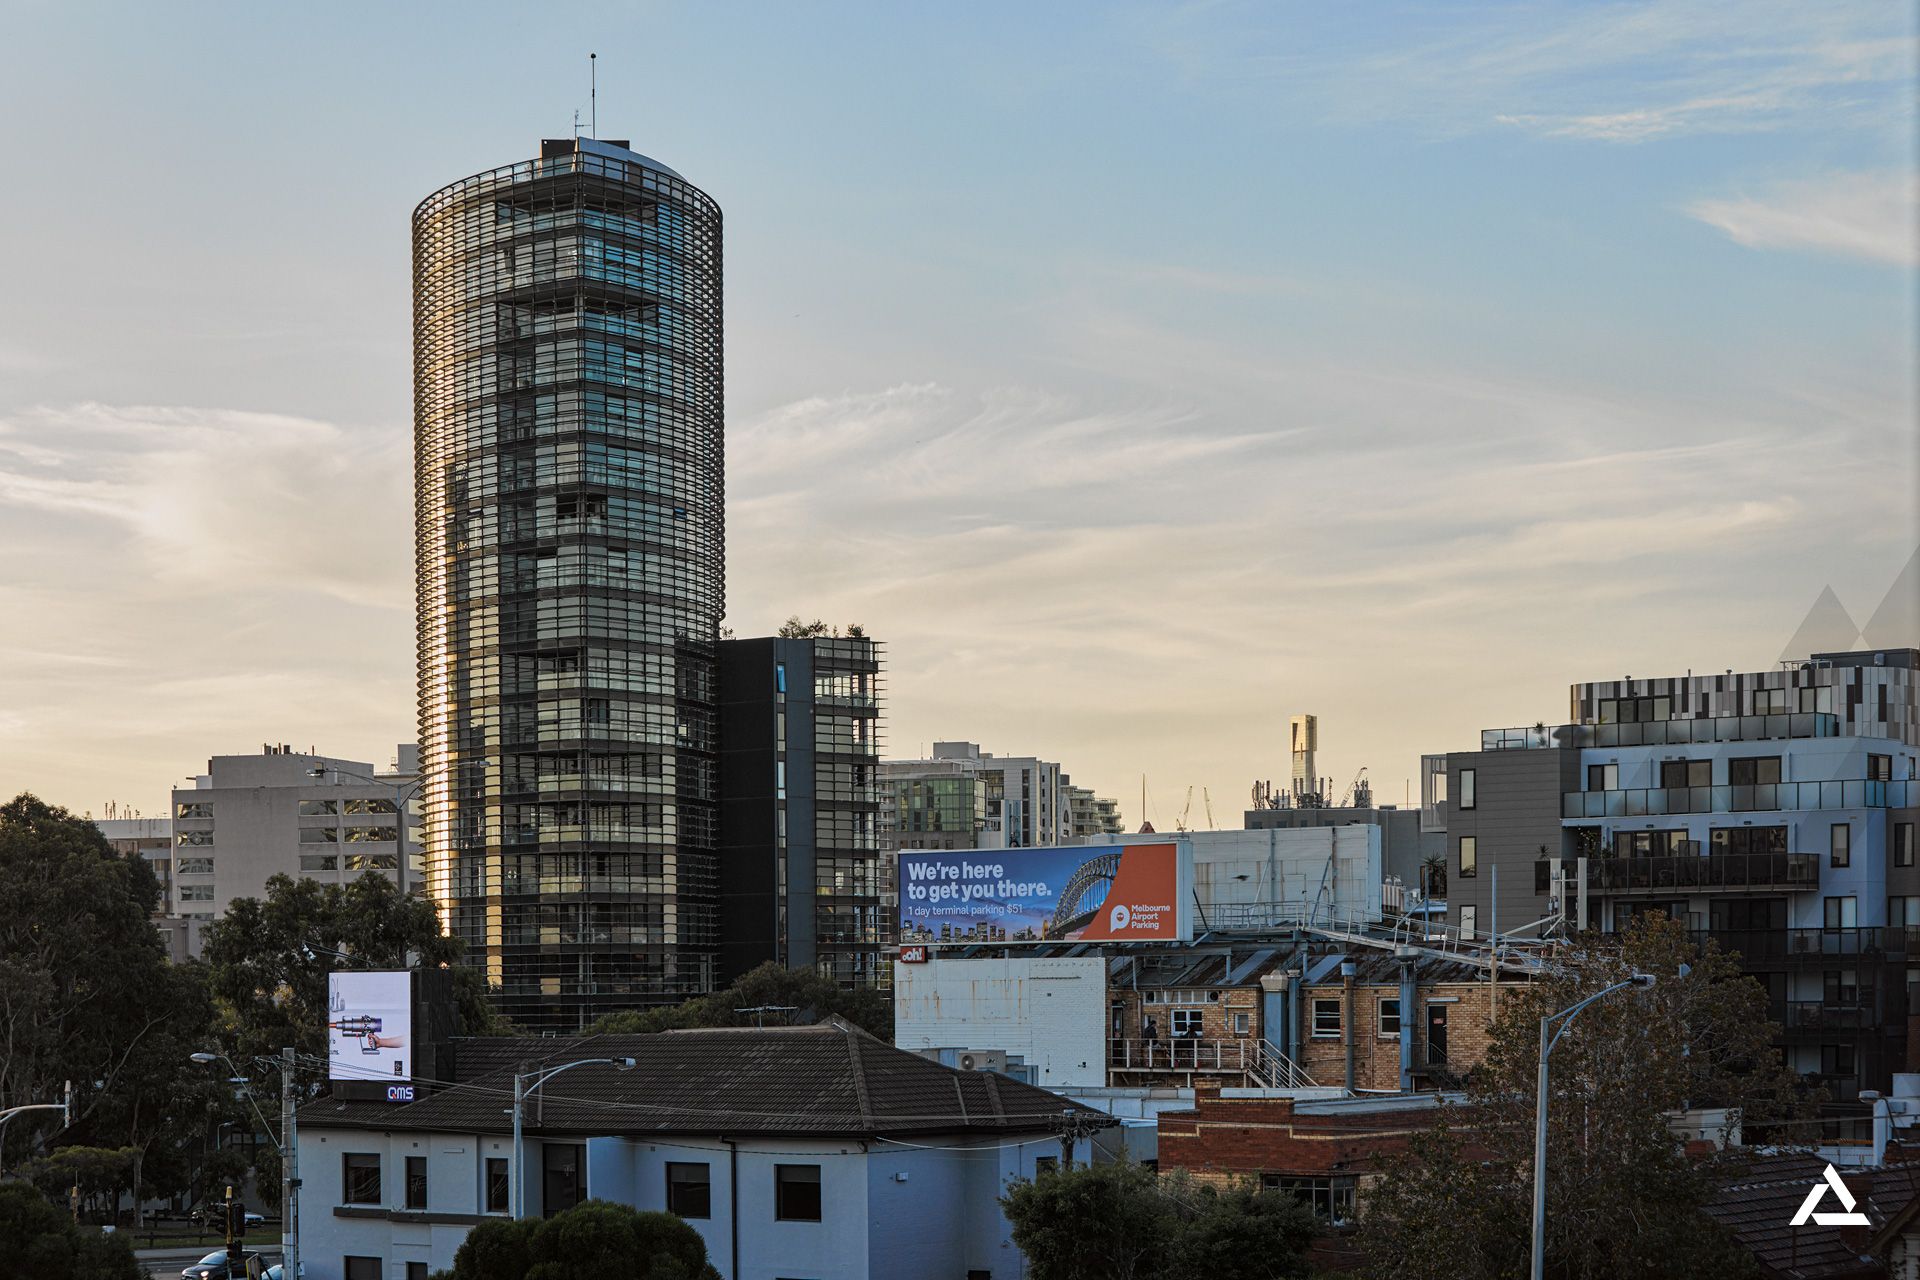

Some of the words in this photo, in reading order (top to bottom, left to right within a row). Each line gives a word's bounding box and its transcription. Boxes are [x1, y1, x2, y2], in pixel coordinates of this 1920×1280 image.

[907, 862, 960, 881] We're
[962, 861, 1004, 880] here
[907, 882, 927, 900] to
[929, 881, 959, 903] get
[961, 883, 995, 903] you
[997, 879, 1053, 898] there.
[908, 906, 913, 916] 1
[914, 905, 931, 918] day
[932, 904, 969, 916] terminal
[971, 904, 1005, 918] parking
[1006, 903, 1023, 914] $51
[1131, 904, 1171, 912] Melbourne
[1131, 912, 1159, 921] Airport
[1131, 921, 1160, 930] Parking
[388, 1086, 414, 1100] QMS
